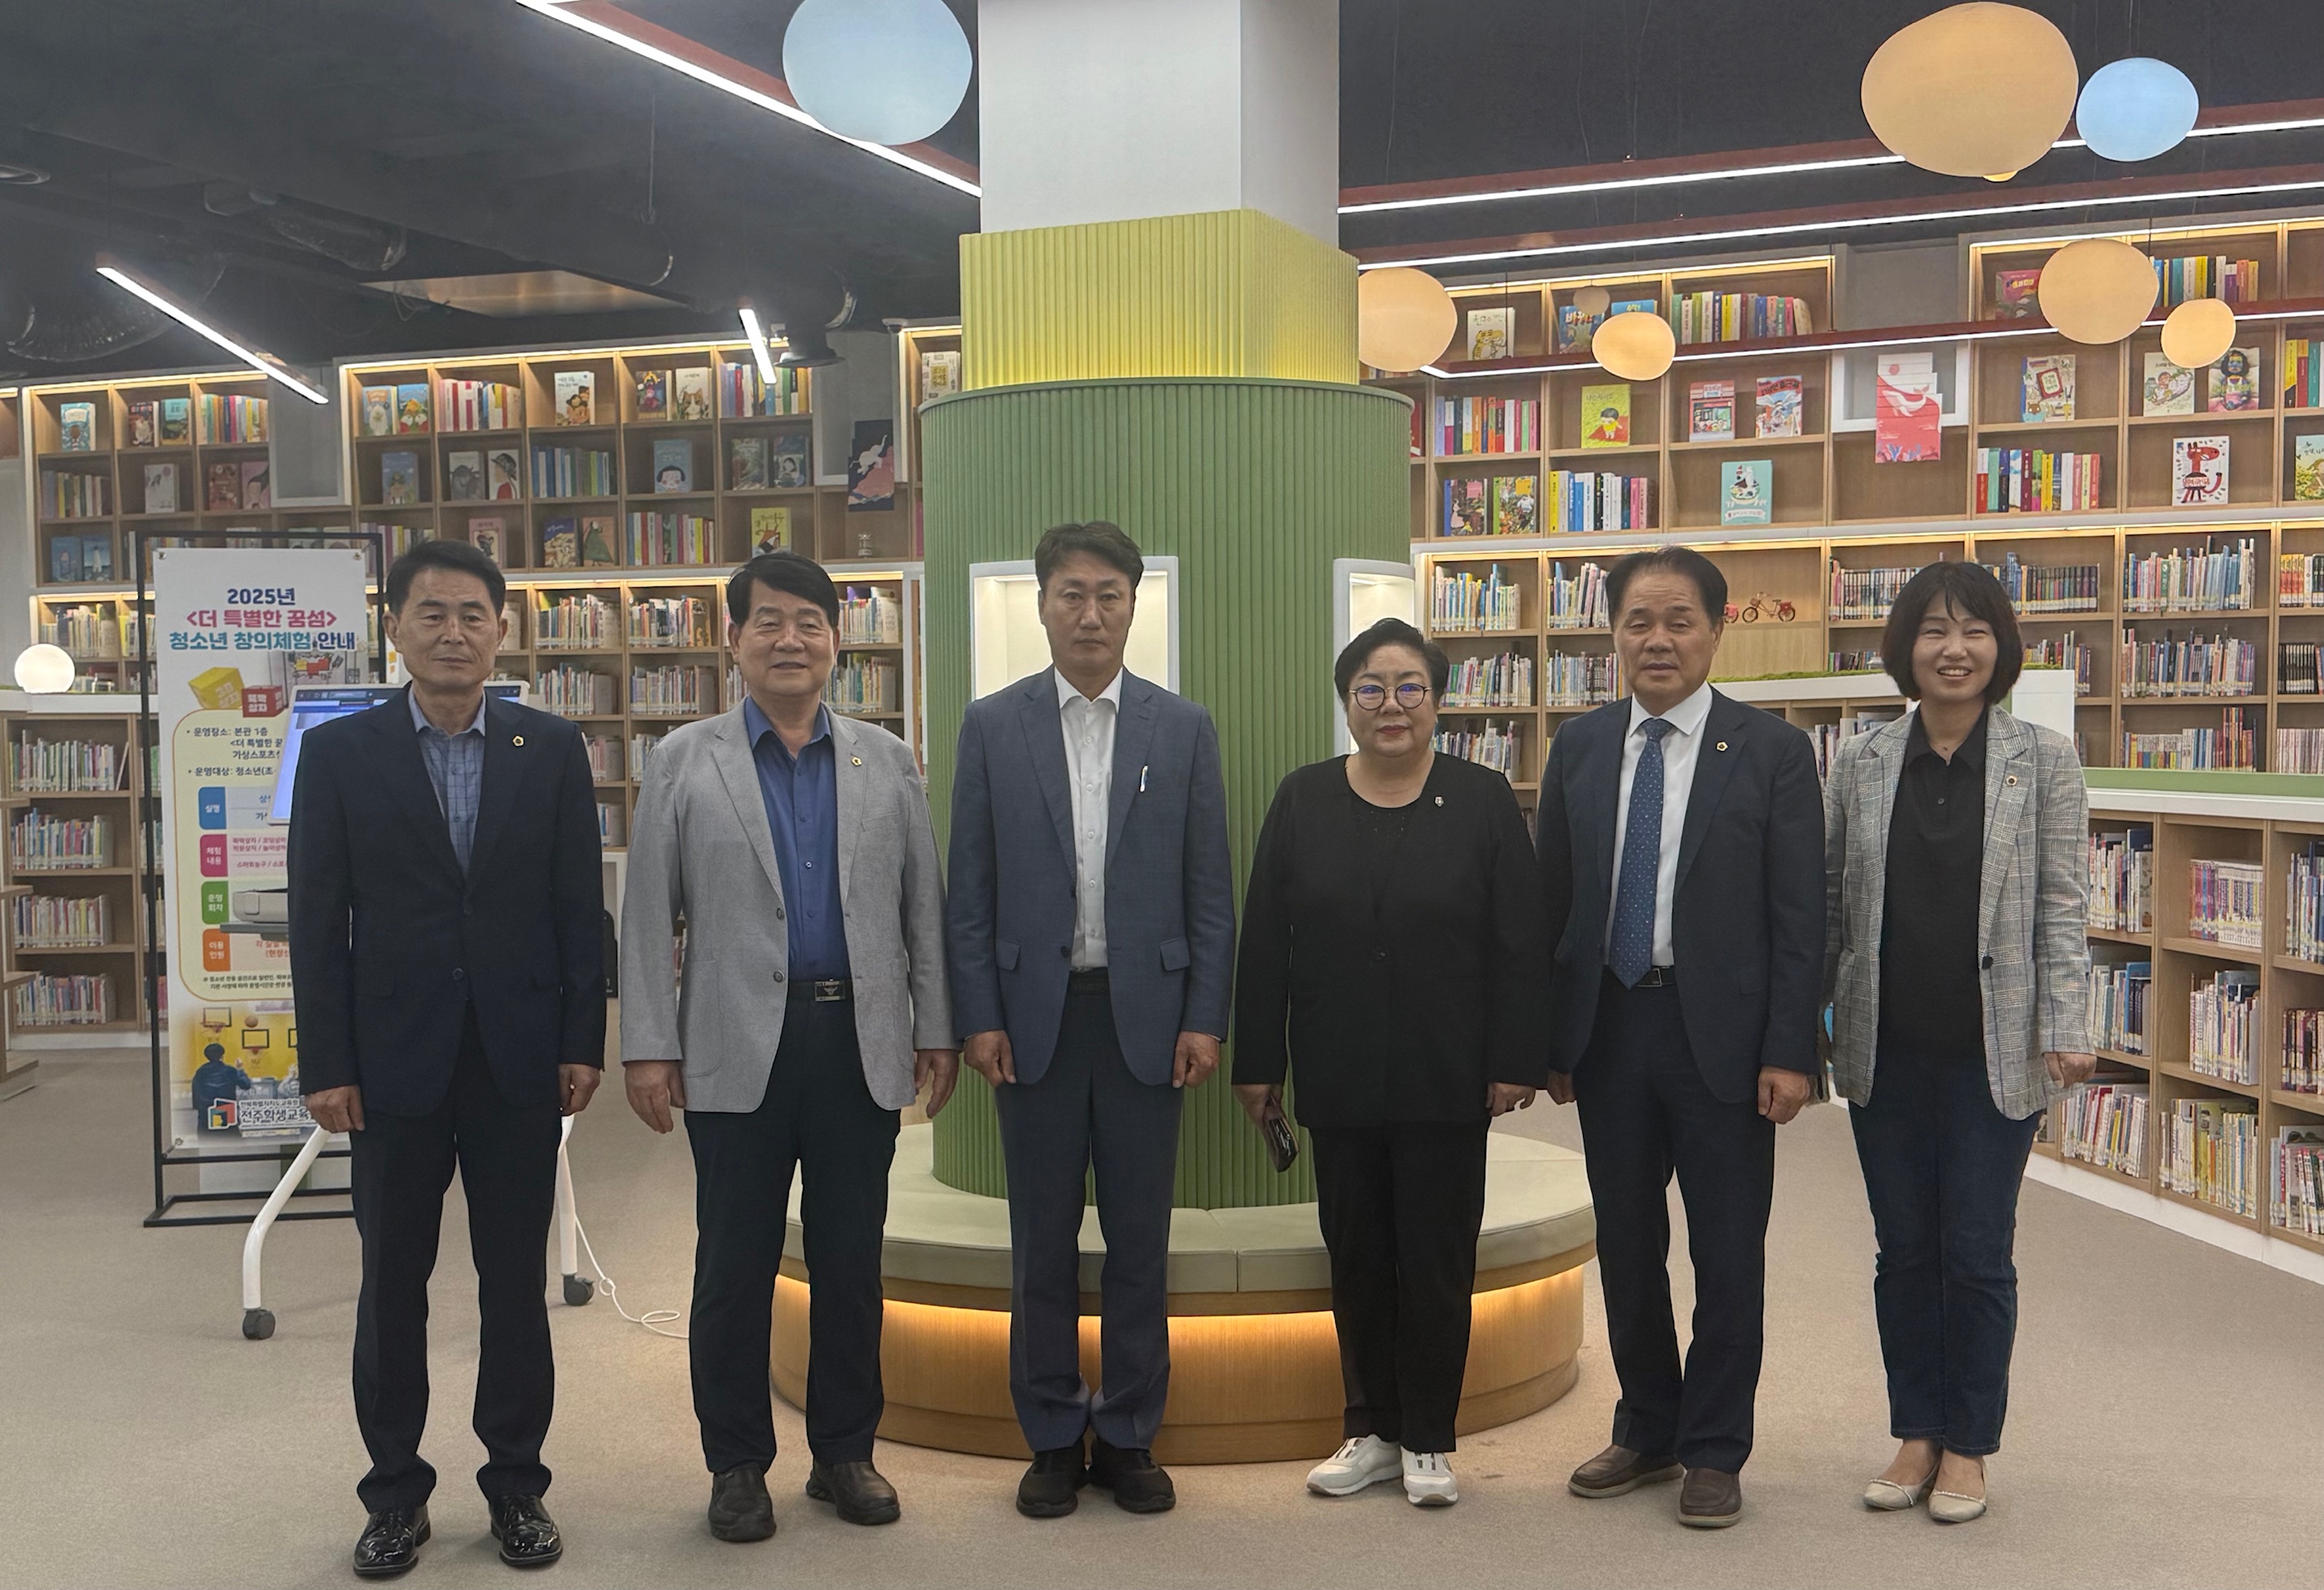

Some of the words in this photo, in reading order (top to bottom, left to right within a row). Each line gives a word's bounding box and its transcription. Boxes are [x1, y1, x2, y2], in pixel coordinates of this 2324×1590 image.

[227, 588, 296, 605] 2025년
[186, 609, 217, 628] <더
[223, 609, 282, 628] 특별한
[287, 609, 337, 628] 꿈섬>
[169, 632, 228, 650] 청소년
[234, 631, 311, 650] 창의체험
[318, 631, 355, 650] 안내
[194, 727, 231, 736] 운영장소:
[235, 727, 251, 736] 본관
[254, 727, 268, 736] 1층
[247, 738, 273, 748] 특별한
[195, 766, 233, 776] 운영대상:
